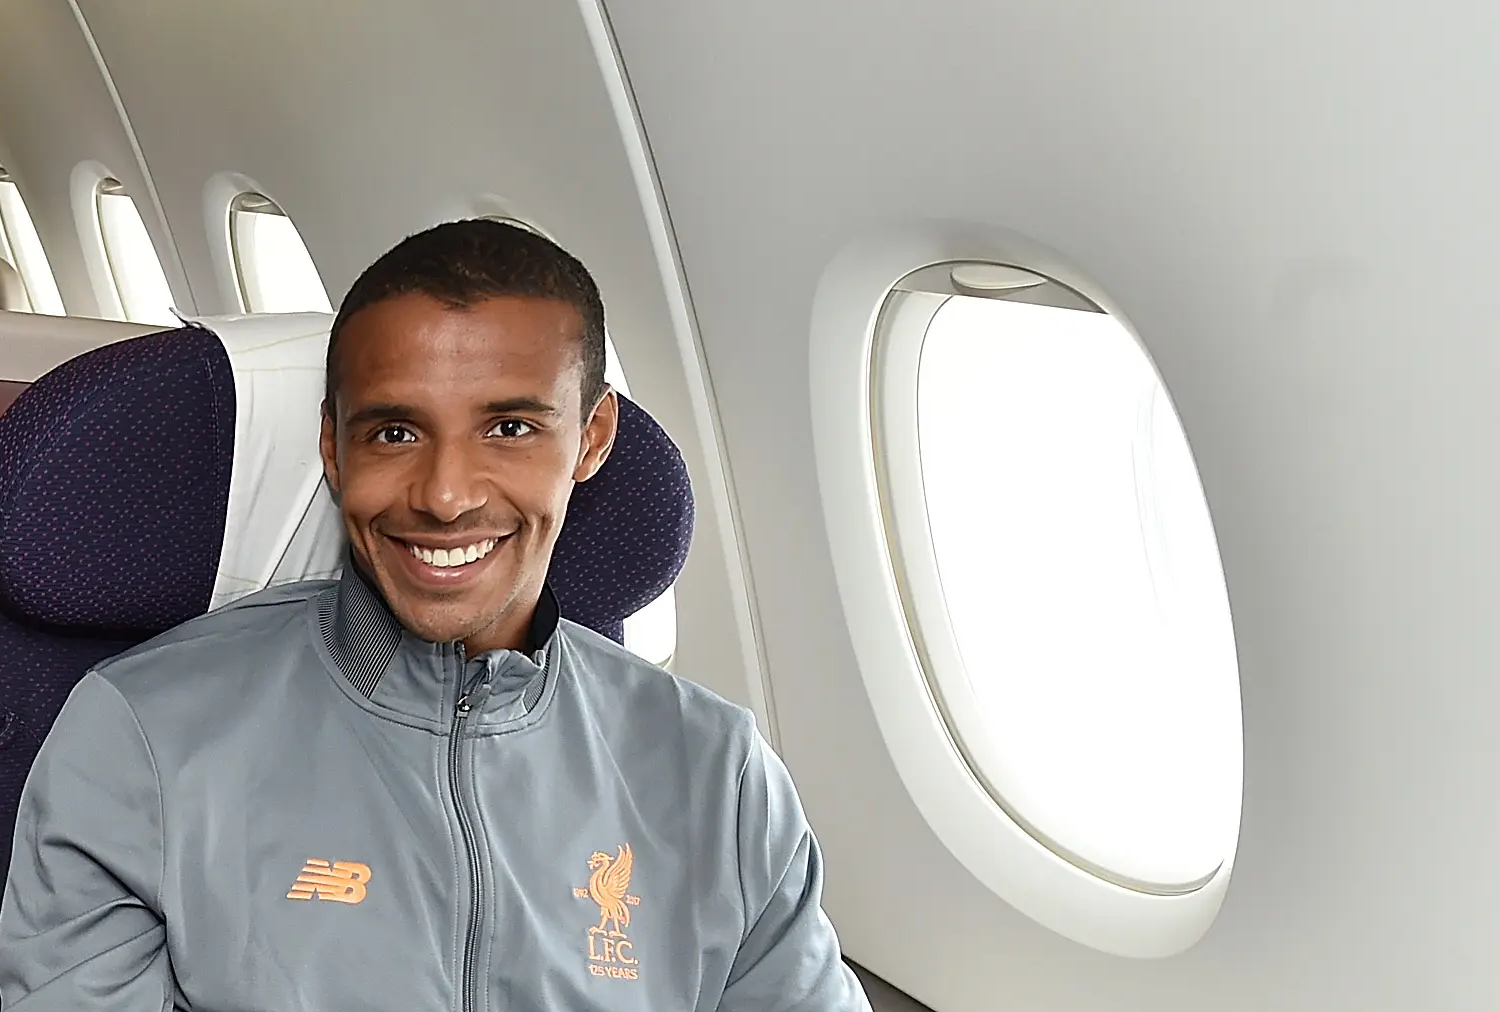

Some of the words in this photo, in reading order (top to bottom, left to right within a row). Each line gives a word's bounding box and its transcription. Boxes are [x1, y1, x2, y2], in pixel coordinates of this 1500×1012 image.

[286, 858, 372, 905] NB
[587, 935, 639, 965] L.F.C.
[588, 963, 605, 977] 125
[604, 965, 639, 980] YEARS
